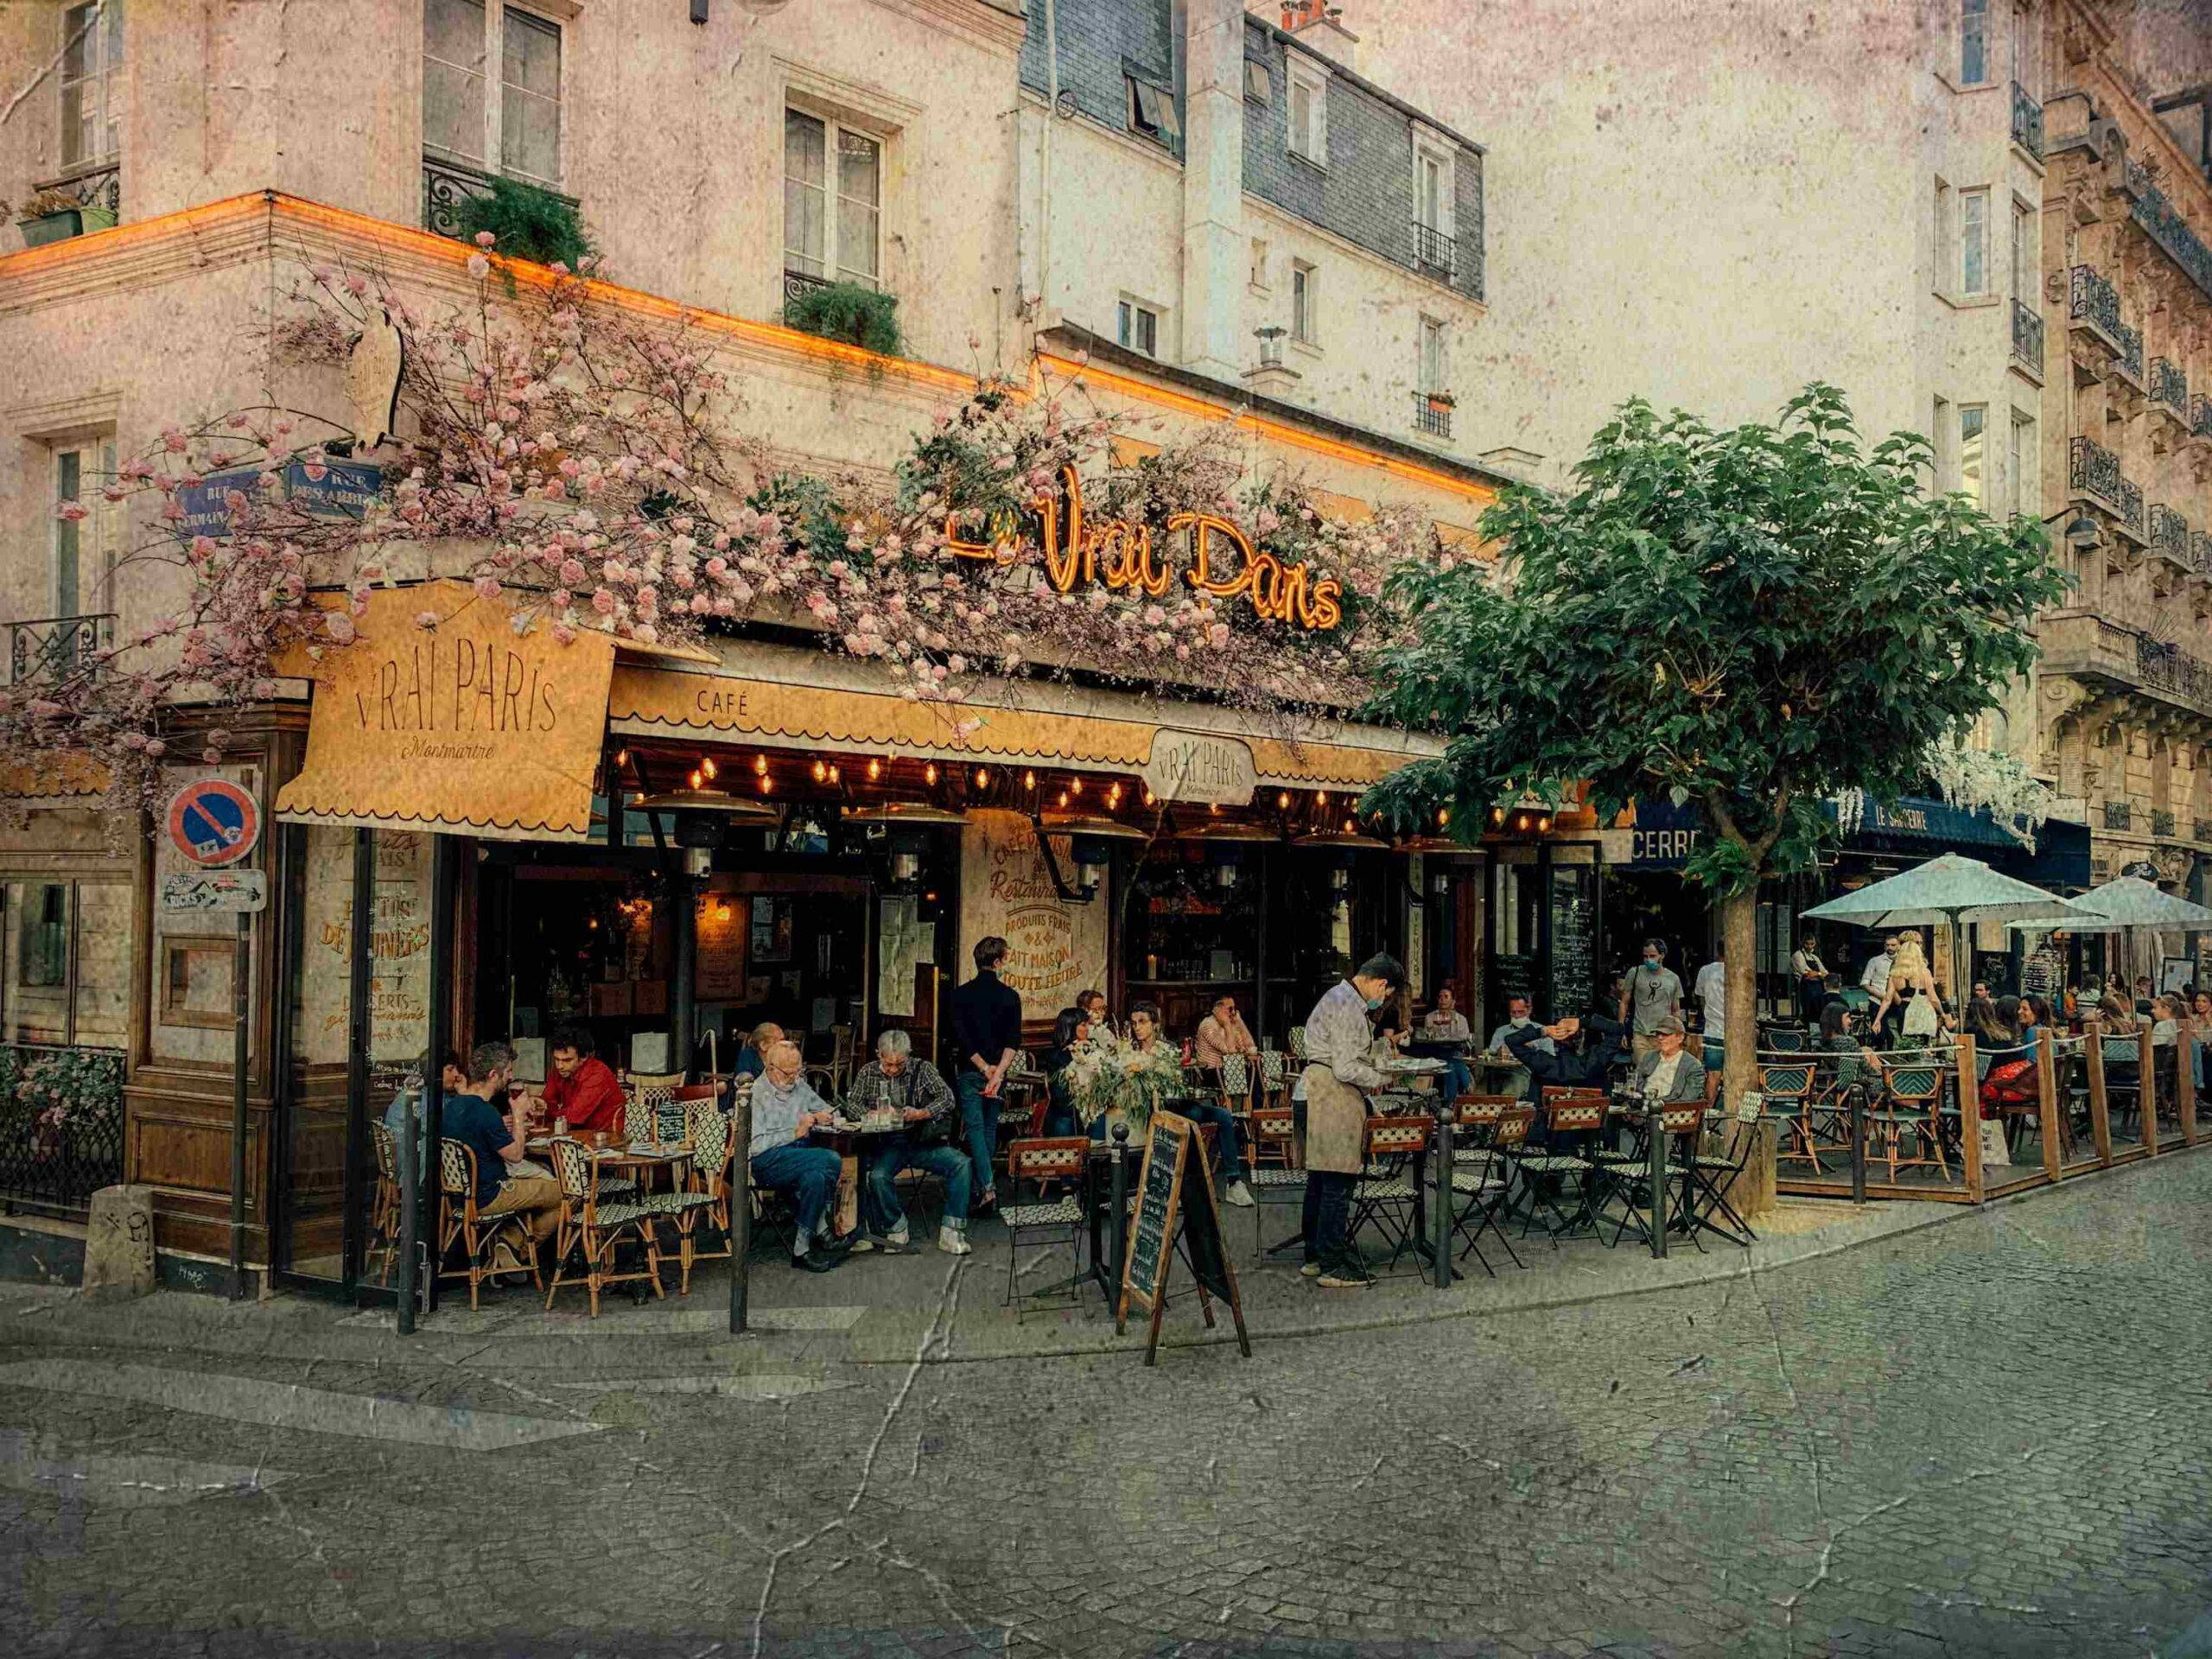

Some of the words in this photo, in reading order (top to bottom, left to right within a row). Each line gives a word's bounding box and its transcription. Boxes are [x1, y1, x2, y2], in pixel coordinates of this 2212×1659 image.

[207, 486, 230, 500] RUE
[332, 473, 366, 488] RUE
[1035, 463, 1171, 596] Vrai
[355, 639, 435, 731] VRAI
[454, 638, 557, 732] PARIS
[696, 690, 747, 716] CAFÉ
[400, 734, 496, 761] Montmartre
[1159, 741, 1196, 783] VRAI
[1203, 741, 1243, 787] PARIS
[1875, 804, 1885, 826] LE
[1005, 913, 1046, 936] PRODUITS
[1048, 914, 1072, 935] FRAIS
[1031, 944, 1071, 969] MAISON
[1046, 960, 1084, 989] HEURE
